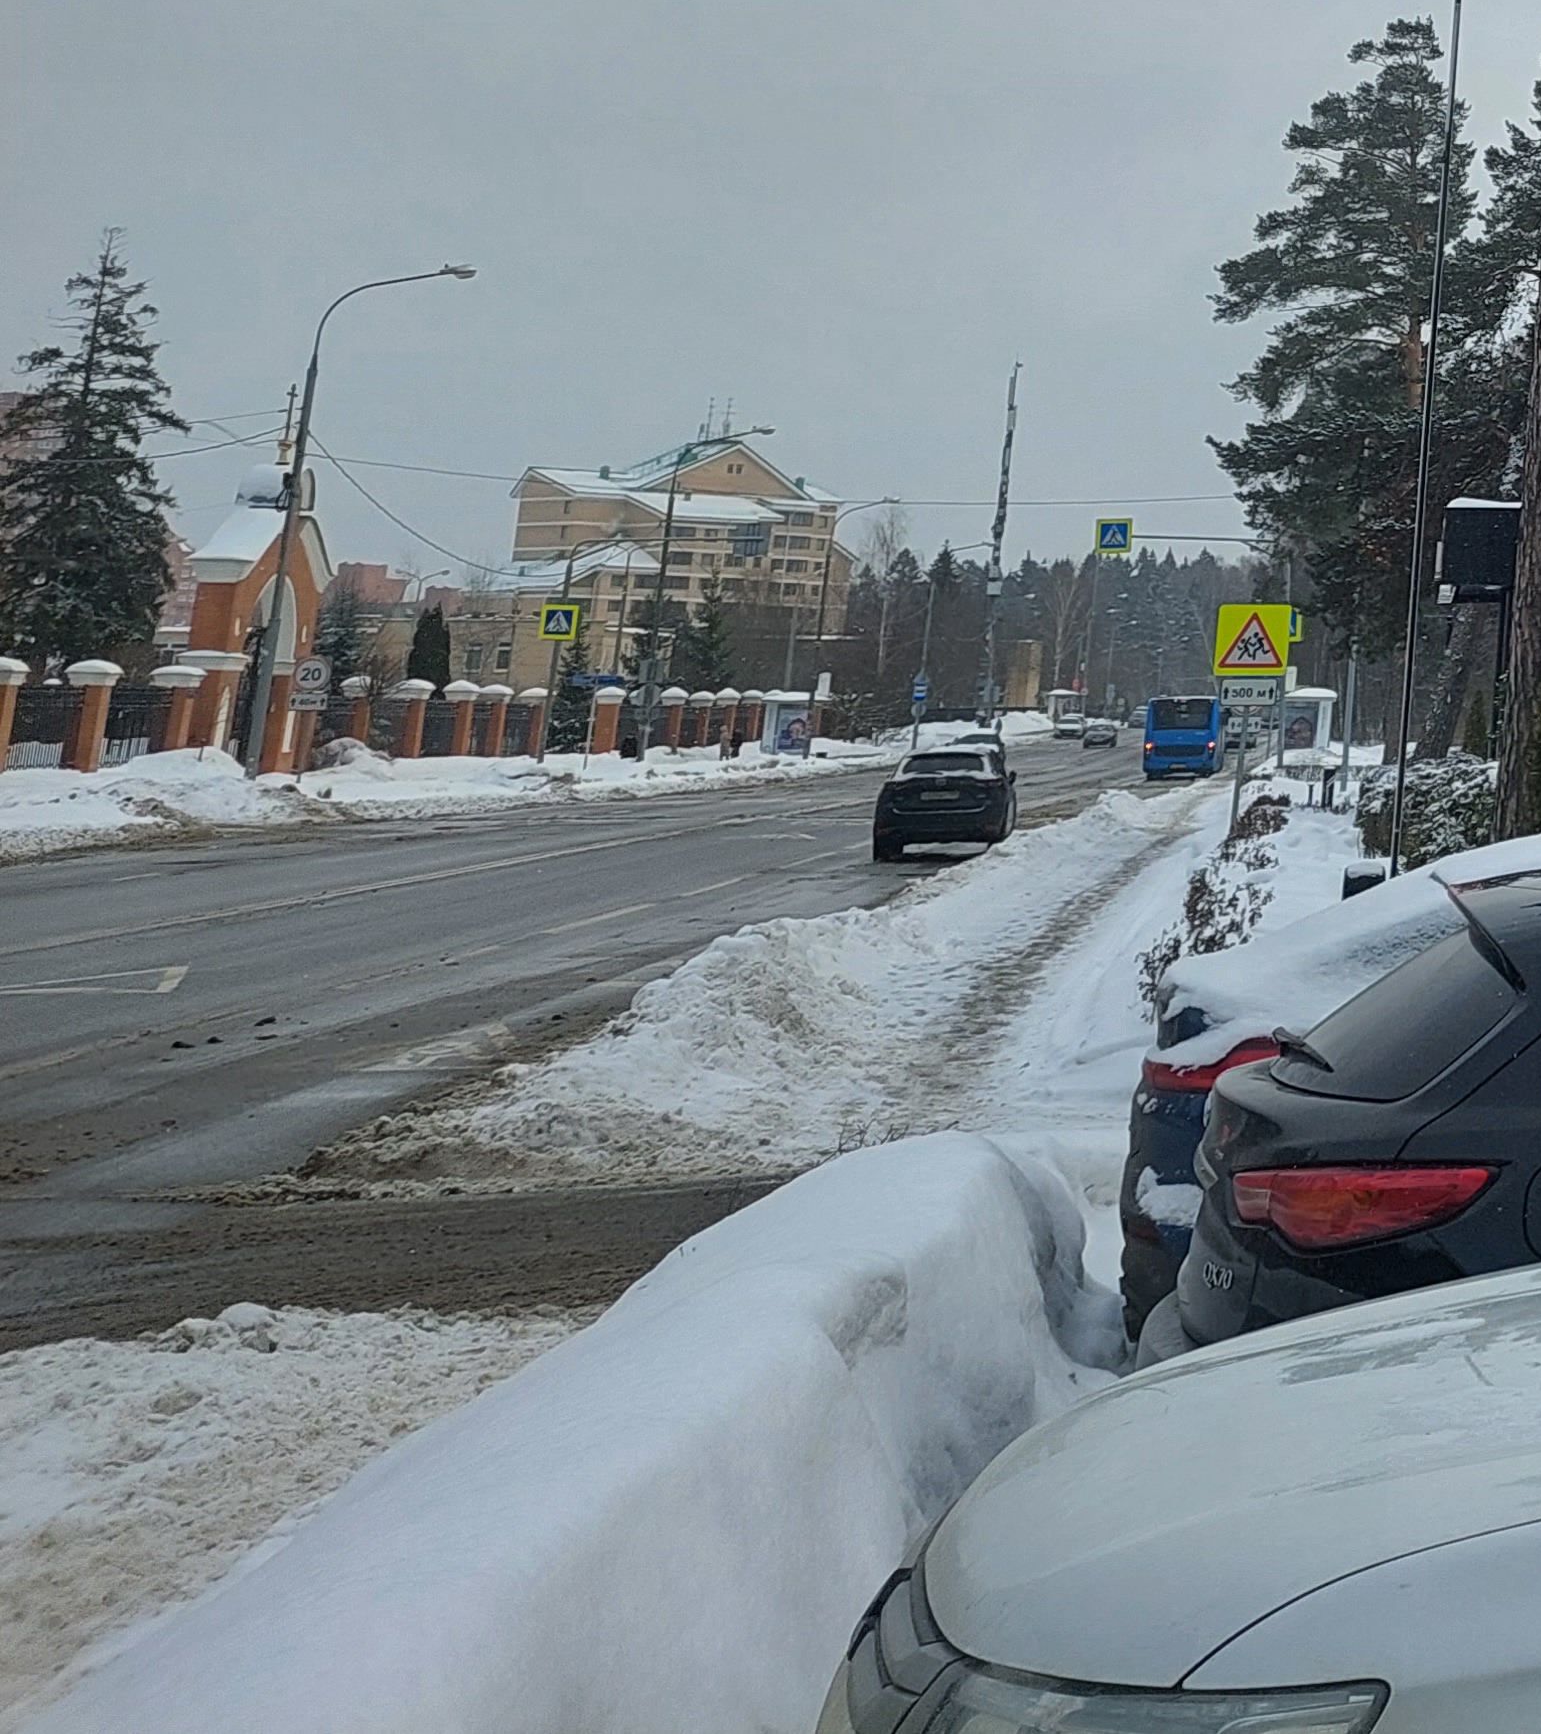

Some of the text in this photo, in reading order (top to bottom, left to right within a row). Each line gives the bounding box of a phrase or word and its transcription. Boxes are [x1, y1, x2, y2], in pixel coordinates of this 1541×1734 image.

[300, 667, 322, 682] 20
[1231, 687, 1254, 699] 500
[1203, 1261, 1233, 1290] QX70
